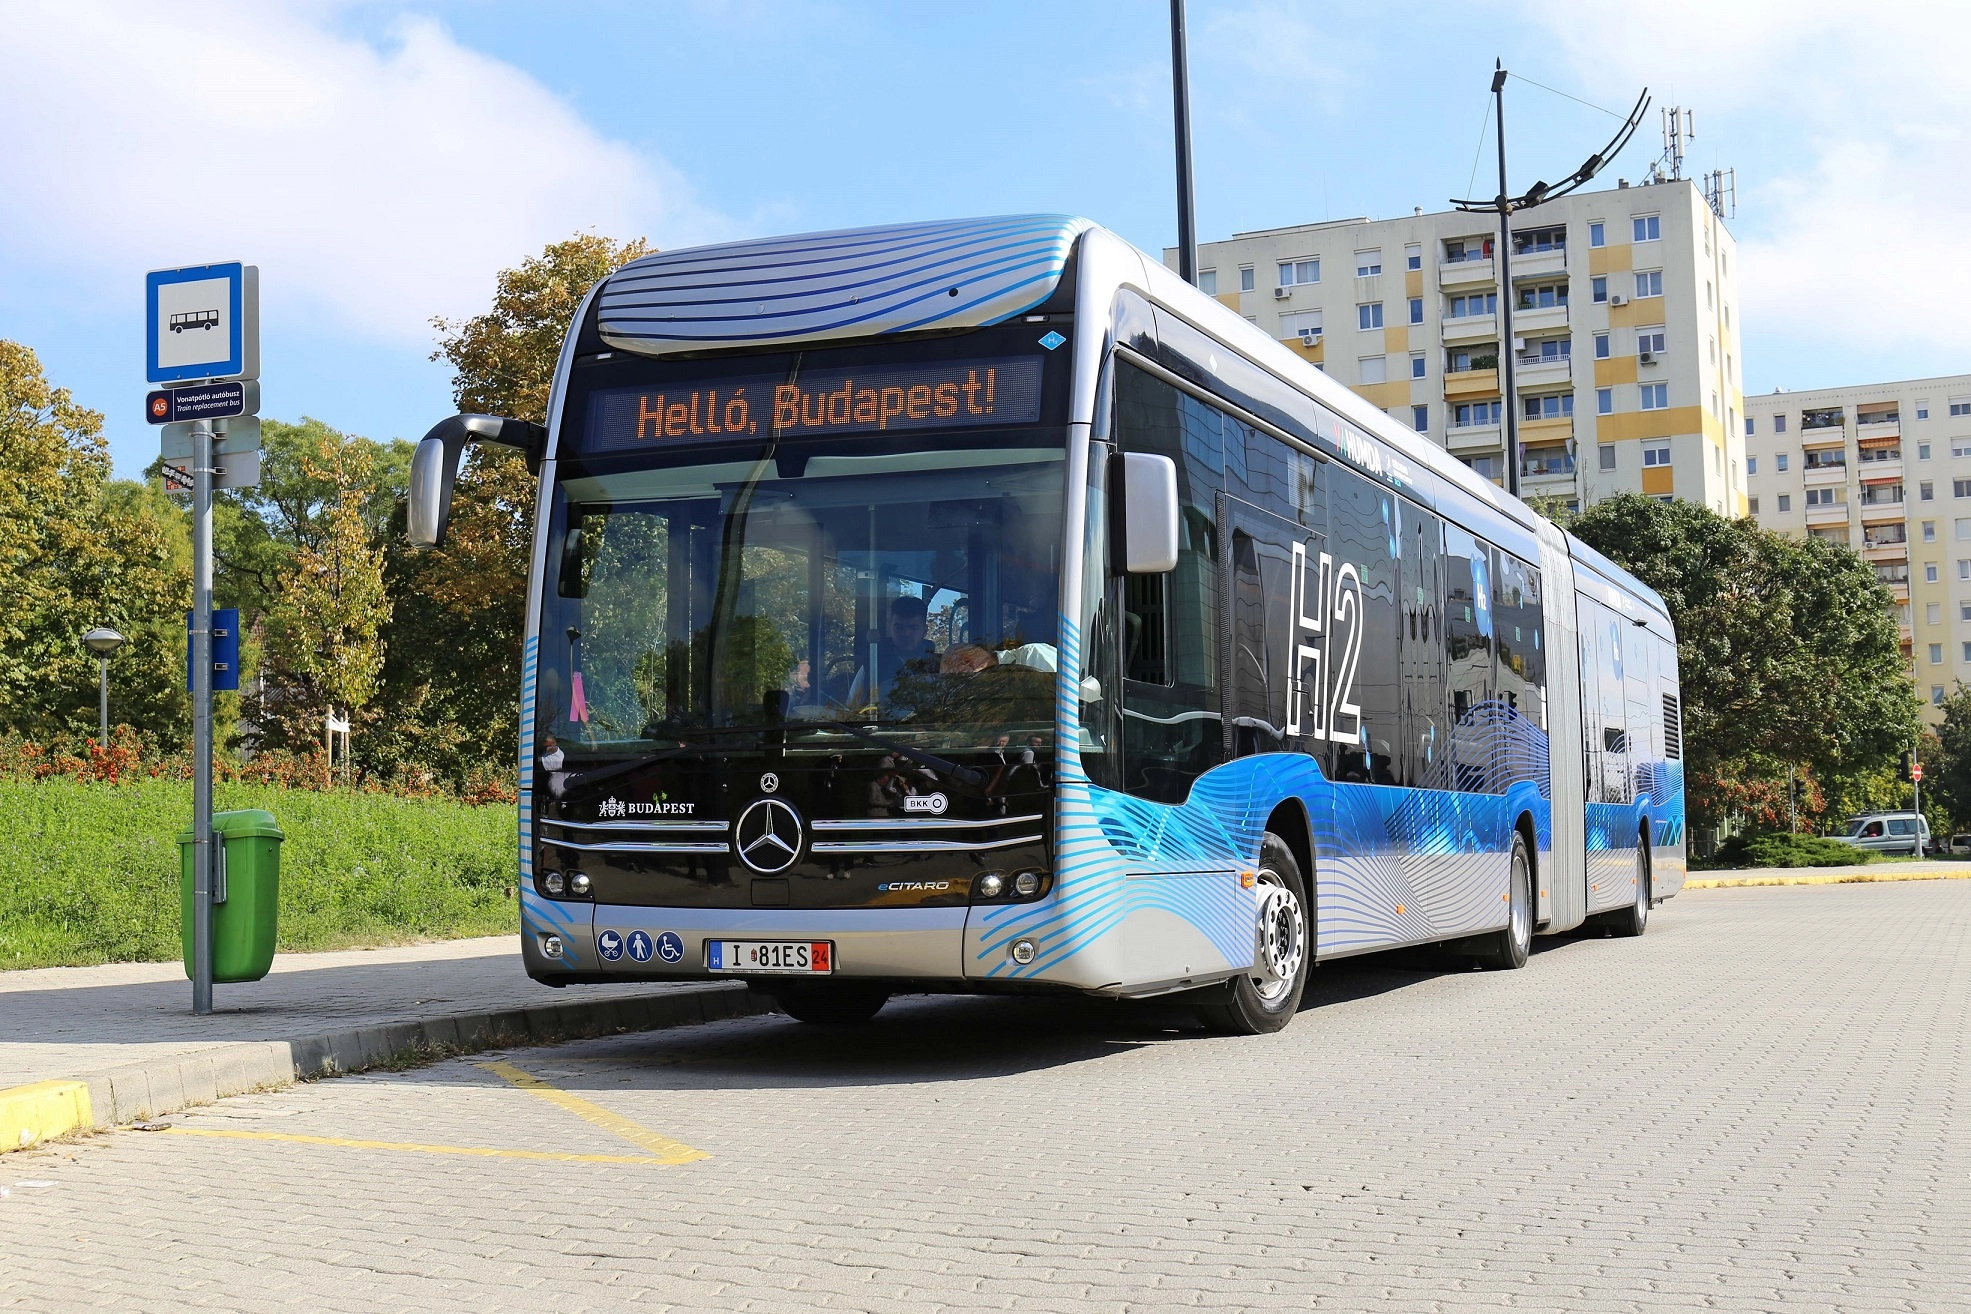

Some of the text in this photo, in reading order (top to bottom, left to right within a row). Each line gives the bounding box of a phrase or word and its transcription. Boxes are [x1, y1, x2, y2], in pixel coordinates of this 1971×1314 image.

[176, 390, 240, 403] Vonatpótló autóbusz
[636, 367, 996, 439] Helló, Budapest!
[153, 402, 166, 412] A5
[192, 400, 229, 411] replacement
[1345, 428, 1383, 477] HUMDA
[1286, 540, 1364, 745] H2
[628, 803, 695, 814] BUDAPEST
[878, 881, 949, 891] eCITARO
[759, 945, 808, 968] 81ES
[812, 950, 828, 964] 24
